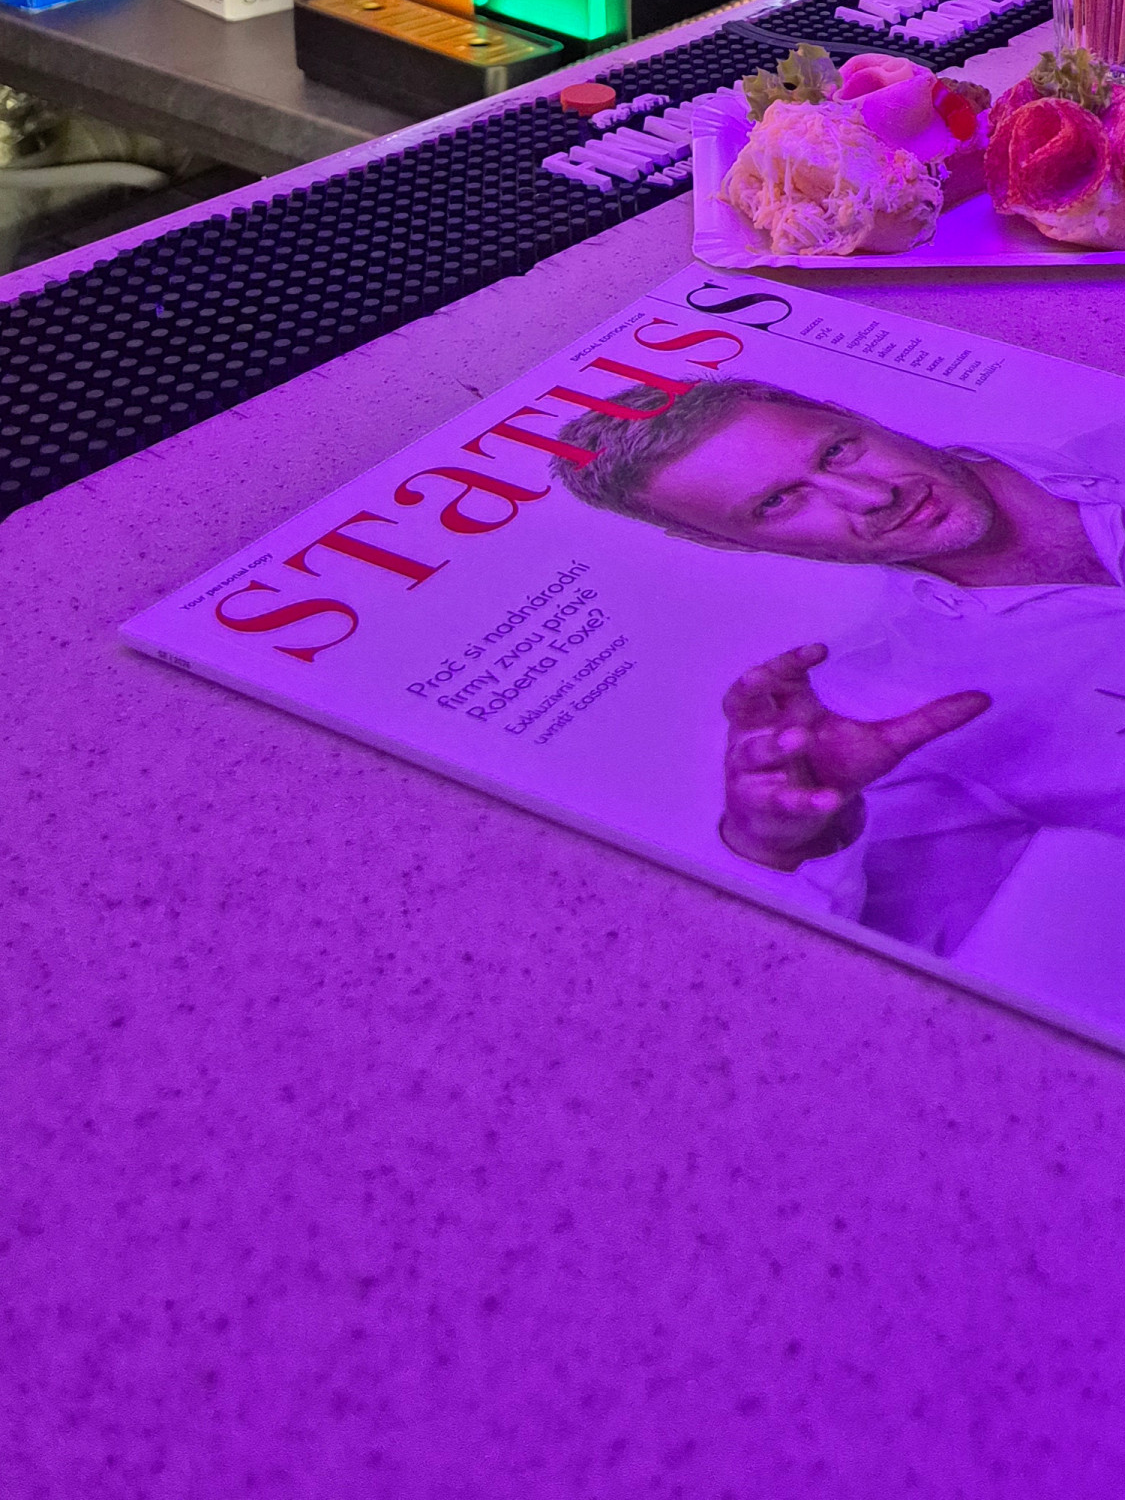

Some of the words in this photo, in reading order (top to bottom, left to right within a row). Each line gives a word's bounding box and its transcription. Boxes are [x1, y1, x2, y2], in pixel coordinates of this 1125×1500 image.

[178, 594, 206, 610] Your
[204, 566, 250, 597] personal
[246, 551, 274, 569] copy
[404, 657, 466, 698] Proč
[462, 642, 487, 660] si
[481, 558, 591, 644] nadnárodní
[435, 669, 501, 710] firmy
[492, 631, 545, 671] zvou
[540, 586, 598, 634] právě
[463, 655, 559, 722] Roberta
[546, 606, 611, 654] Foxe?
[502, 678, 576, 735] Exkluzivní
[571, 633, 629, 682] rozhovor
[532, 708, 575, 745] uvnitř
